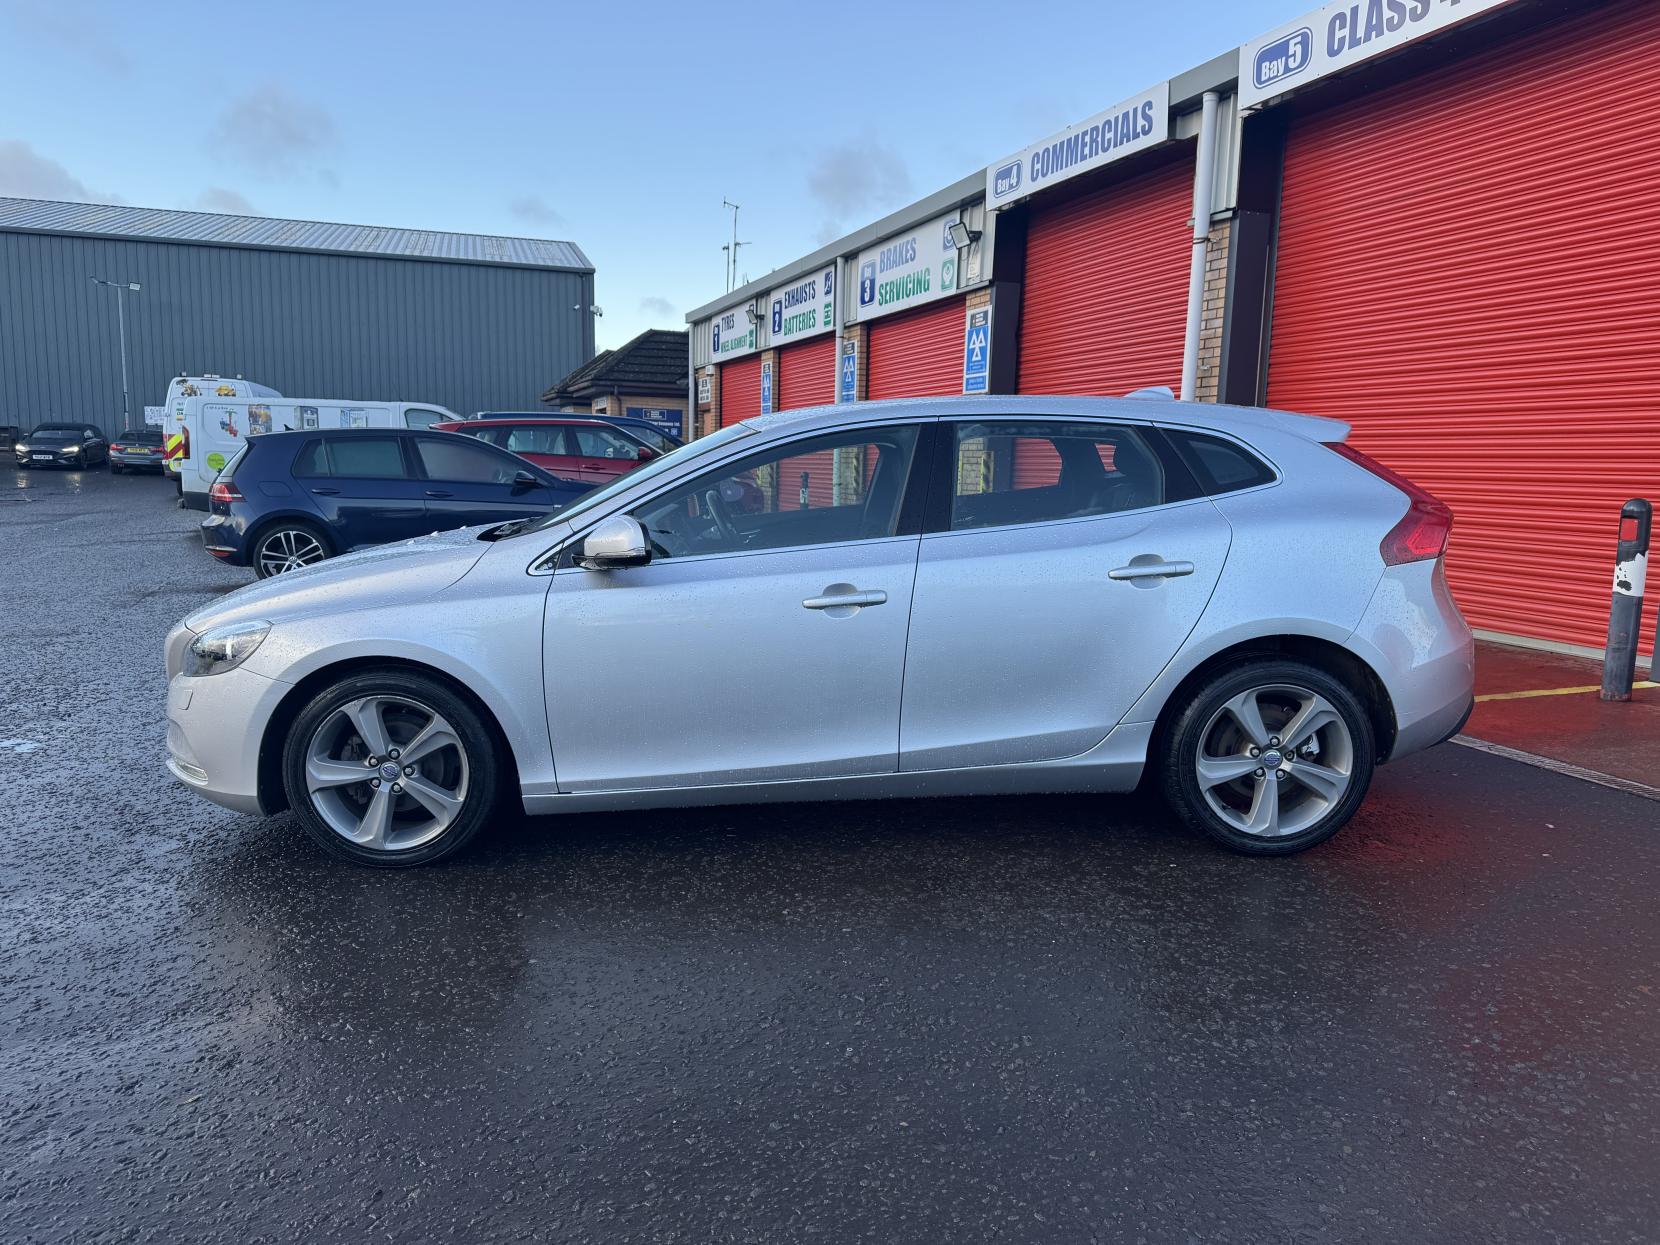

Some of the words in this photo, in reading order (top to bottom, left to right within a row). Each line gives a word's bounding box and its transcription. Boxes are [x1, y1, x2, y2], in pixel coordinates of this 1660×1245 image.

[1261, 57, 1285, 81] Bay
[1288, 36, 1303, 69] 5
[1030, 100, 1154, 183] COMMERCIALS
[997, 176, 1010, 193] Bay
[1009, 164, 1018, 188] 4
[879, 237, 917, 274] BRAKES
[784, 279, 816, 309] EXHAUSTS
[864, 280, 871, 303] 3
[878, 267, 931, 306] SERVICING
[721, 313, 735, 333] TYRES
[774, 313, 779, 332] 2
[783, 308, 817, 336] BATTERIES
